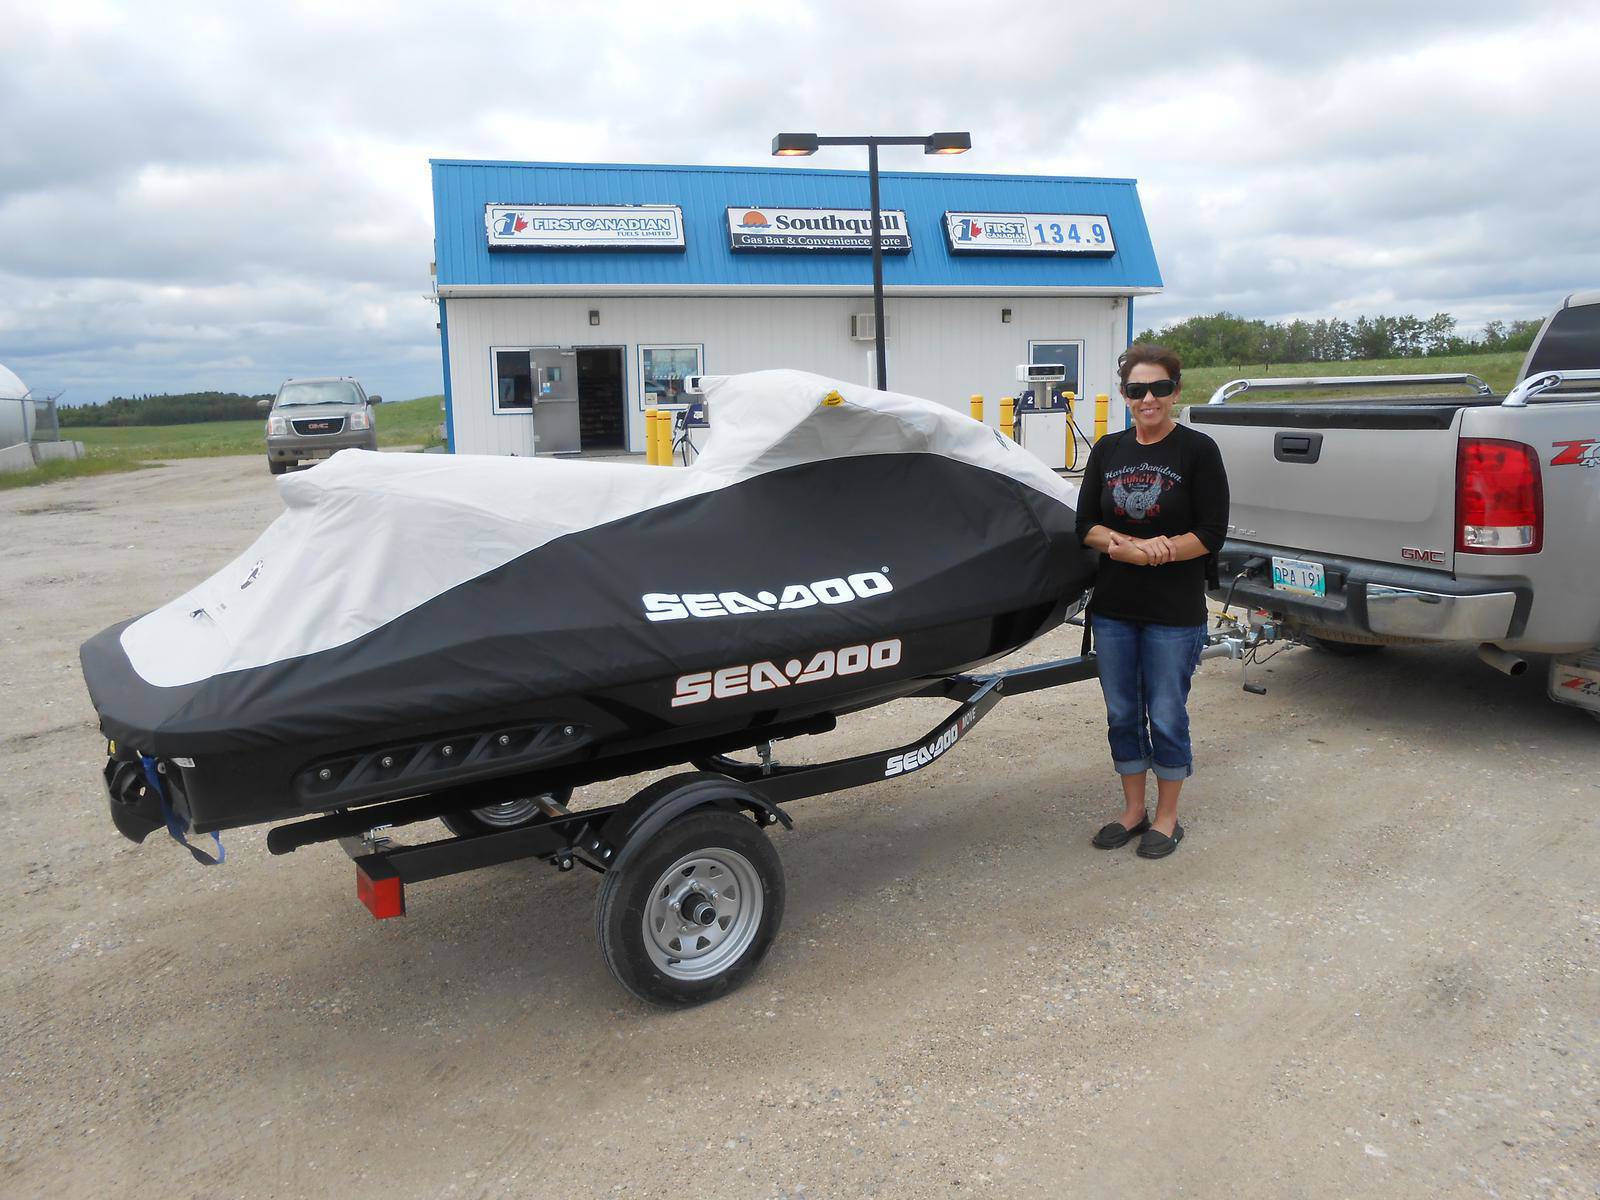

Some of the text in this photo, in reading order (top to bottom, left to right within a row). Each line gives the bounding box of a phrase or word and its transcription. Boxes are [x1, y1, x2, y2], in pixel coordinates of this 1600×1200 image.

[984, 222, 1025, 234] FIRST
[1034, 223, 1106, 244] 134.9
[741, 235, 763, 245] Gas
[765, 236, 785, 245] Bar
[787, 236, 797, 245] &
[798, 237, 871, 246] Convenience
[985, 232, 1026, 240] CANADIAN
[1401, 548, 1446, 564] GMC
[1274, 566, 1296, 586] DPA
[1302, 571, 1321, 590] 191
